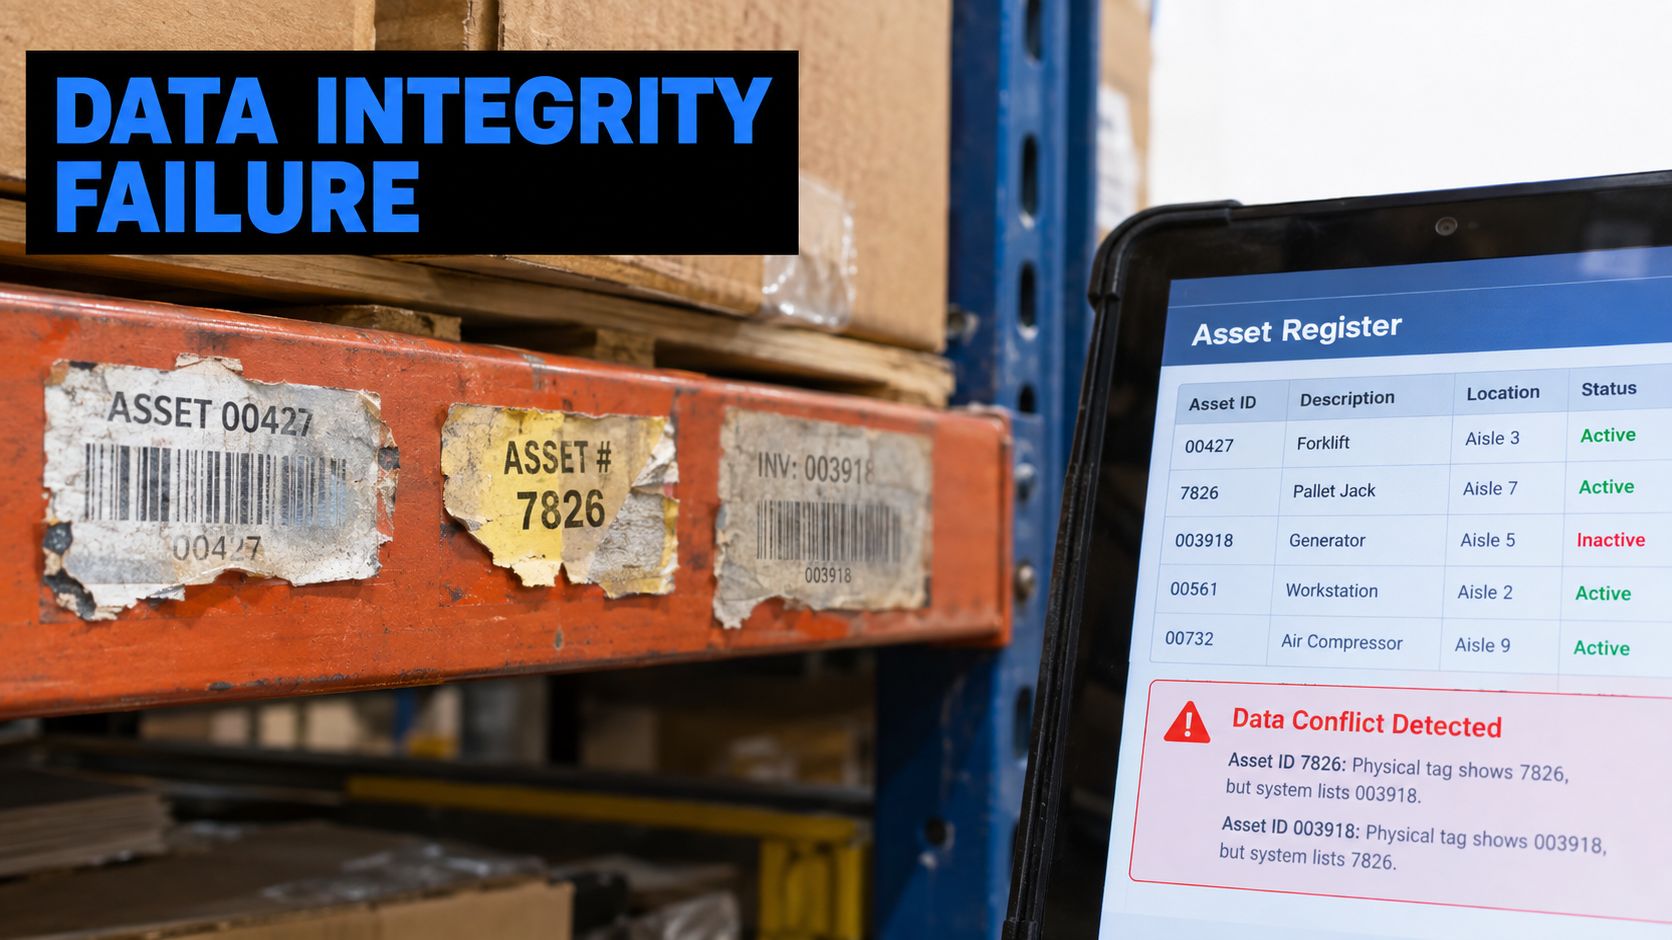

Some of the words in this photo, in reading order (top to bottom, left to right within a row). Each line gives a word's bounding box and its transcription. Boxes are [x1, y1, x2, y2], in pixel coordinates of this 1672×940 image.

[1192, 321, 1272, 347] Asset
[1282, 315, 1402, 344] Register
[1467, 384, 1540, 401] Location
[1581, 382, 1637, 396] Status
[1189, 396, 1235, 411] Asset
[1240, 395, 1257, 409] ID
[1300, 390, 1395, 409] Description
[108, 391, 212, 429] ASSET
[222, 401, 313, 437] 00427
[1297, 435, 1350, 450] Forklift
[1465, 431, 1505, 446] Aisle
[1510, 430, 1520, 445] 3
[1580, 428, 1636, 443] Active
[1185, 439, 1234, 453] 00427
[504, 440, 589, 475] ASSET
[596, 441, 612, 472] #
[758, 453, 797, 480] INV:
[805, 455, 875, 485] 003918
[1180, 486, 1219, 500] 7826
[1293, 483, 1336, 499] Pallet
[1340, 483, 1376, 498] Jack
[1463, 481, 1503, 496] Aisle
[1508, 481, 1518, 495] 7
[1579, 480, 1635, 495] Active
[516, 489, 605, 529] 7826
[1175, 533, 1233, 547] 003918
[1289, 533, 1366, 547] Generator
[1460, 533, 1500, 547] Aisle
[1506, 533, 1516, 547] 5
[1577, 532, 1646, 547] Inactive
[805, 568, 851, 583] 003918
[1170, 582, 1218, 597] 00561
[1286, 583, 1379, 598] Workstation
[1458, 584, 1497, 600] Aisle
[1503, 585, 1513, 600] 2
[1575, 585, 1631, 601] Active
[1165, 630, 1214, 646] 00732
[1281, 634, 1303, 648] Air
[1307, 635, 1403, 653] Compressor
[1455, 637, 1495, 652] Aisle
[1500, 638, 1511, 652] 9
[1573, 640, 1630, 656] Active
[1233, 708, 1285, 730] Data
[1292, 710, 1384, 734] Conflict
[1392, 714, 1502, 738] Detected
[1228, 752, 1273, 770] Asset
[1278, 755, 1295, 770] ID
[1301, 755, 1346, 772] 7826:
[1352, 758, 1420, 778] Physical
[1426, 761, 1453, 780] tag
[1458, 762, 1513, 780] shows
[1520, 764, 1569, 785] 7826,
[1226, 779, 1251, 796] but
[1256, 782, 1312, 802] system
[1318, 783, 1350, 800] lists
[1355, 785, 1422, 804] 003918.
[1222, 816, 1267, 833] Asset
[1272, 819, 1288, 834] ID
[1293, 820, 1360, 839] 003918:
[1366, 825, 1434, 845] Physical
[1440, 829, 1467, 849] tag
[1473, 831, 1528, 849] shows
[1534, 833, 1607, 856] 003918,
[1220, 843, 1245, 860] but
[1250, 846, 1307, 867] system
[1312, 850, 1345, 867] lists
[1351, 852, 1397, 871] 7826.
